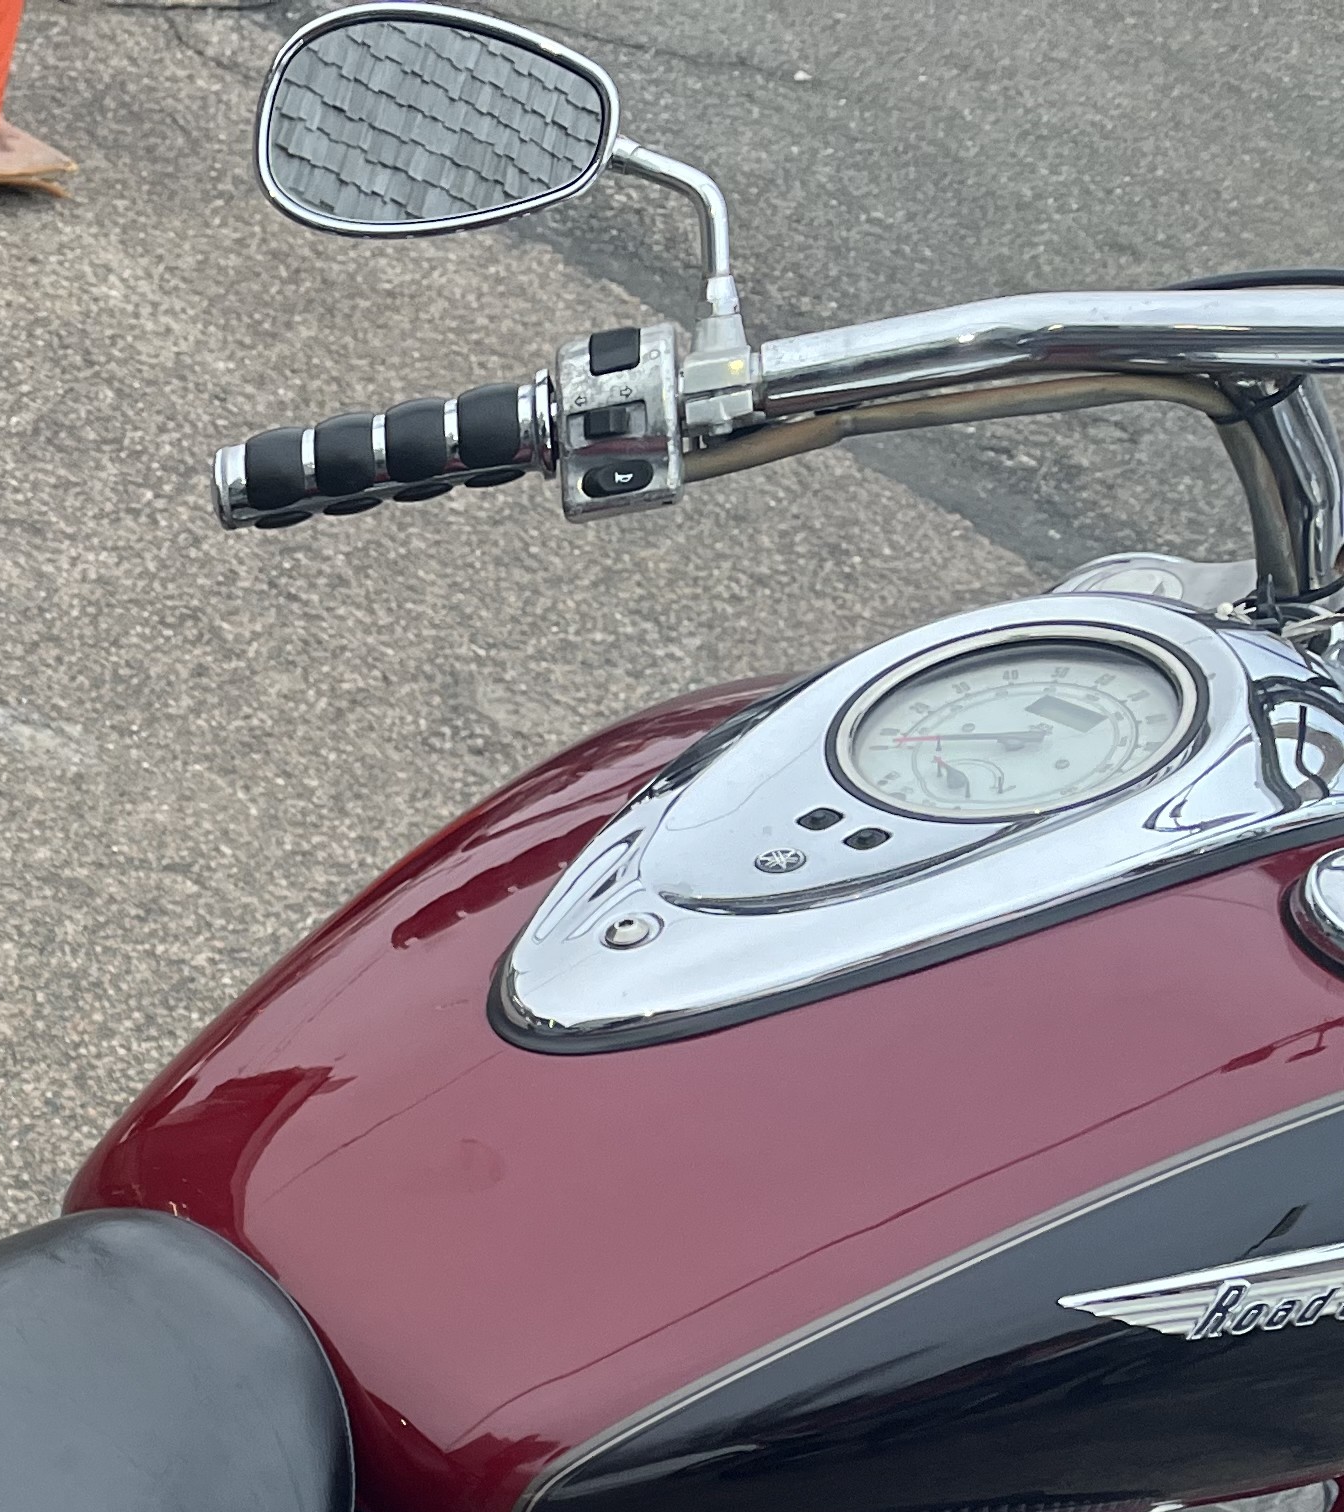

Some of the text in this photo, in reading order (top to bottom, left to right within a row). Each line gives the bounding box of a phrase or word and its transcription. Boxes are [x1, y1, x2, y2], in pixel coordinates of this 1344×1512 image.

[1002, 669, 1020, 680] 40
[1050, 666, 1071, 678] 50
[952, 681, 971, 694] 30
[1185, 1277, 1342, 1339] Road
